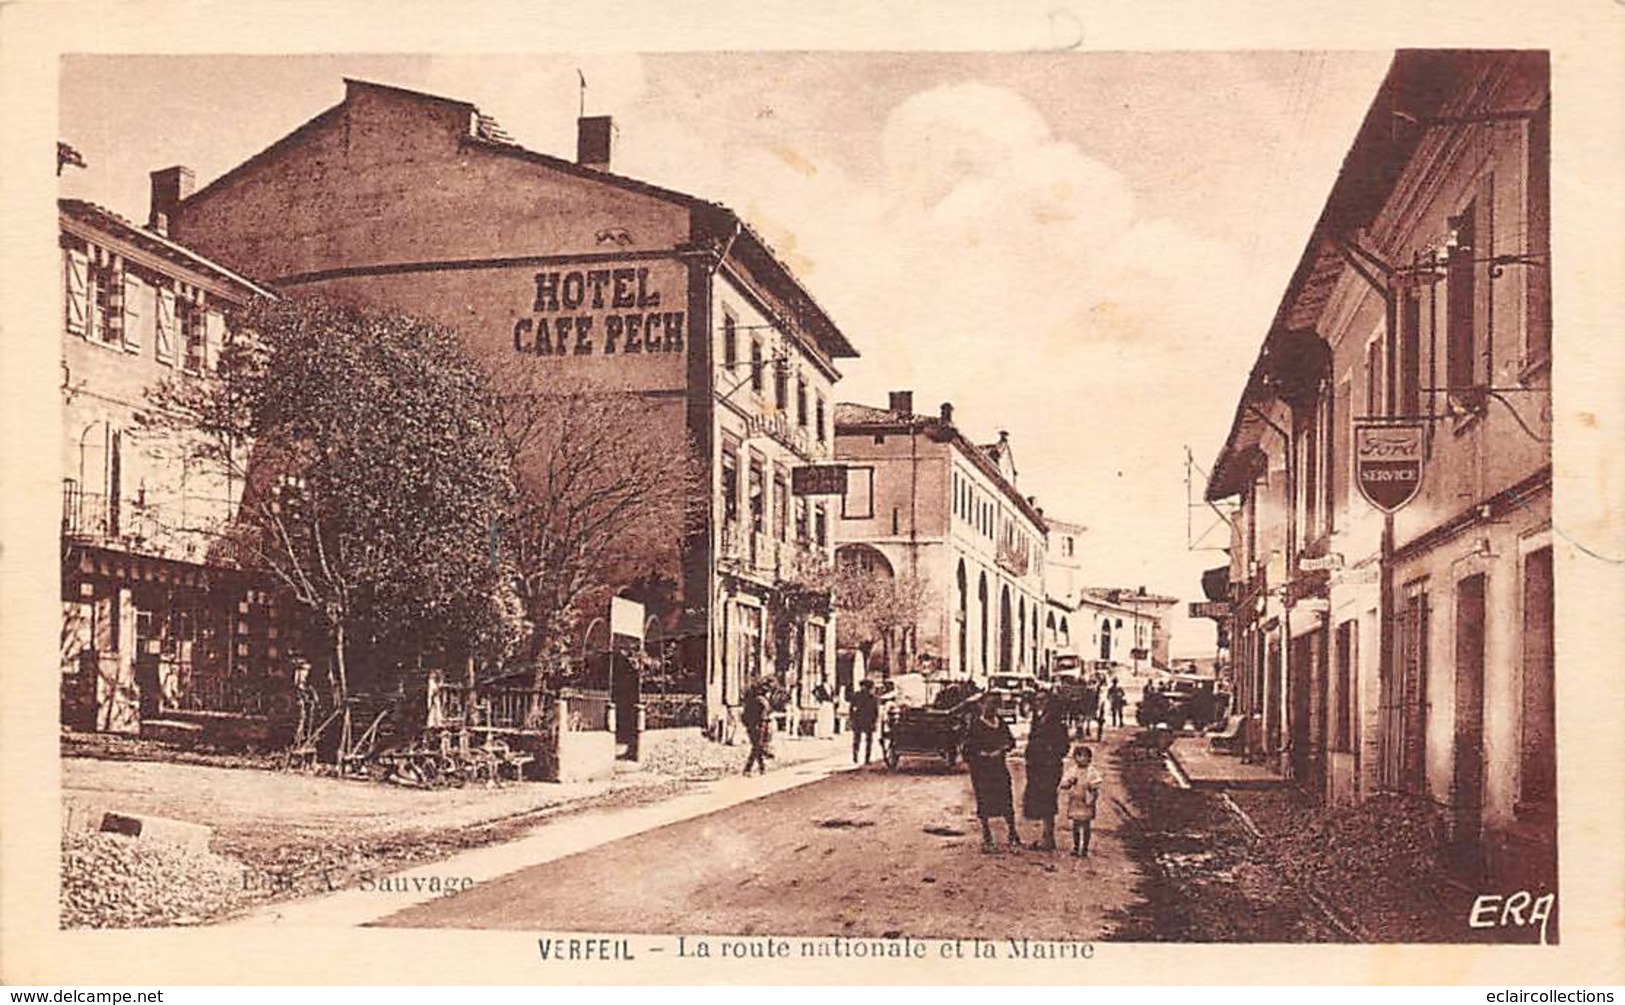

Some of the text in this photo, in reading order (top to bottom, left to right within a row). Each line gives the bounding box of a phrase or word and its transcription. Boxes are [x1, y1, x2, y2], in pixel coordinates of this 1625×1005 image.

[533, 268, 661, 312] HOTEL
[514, 312, 684, 356] CAFE PECH
[1360, 437, 1418, 456] Ford
[1361, 469, 1417, 481] SERVICE
